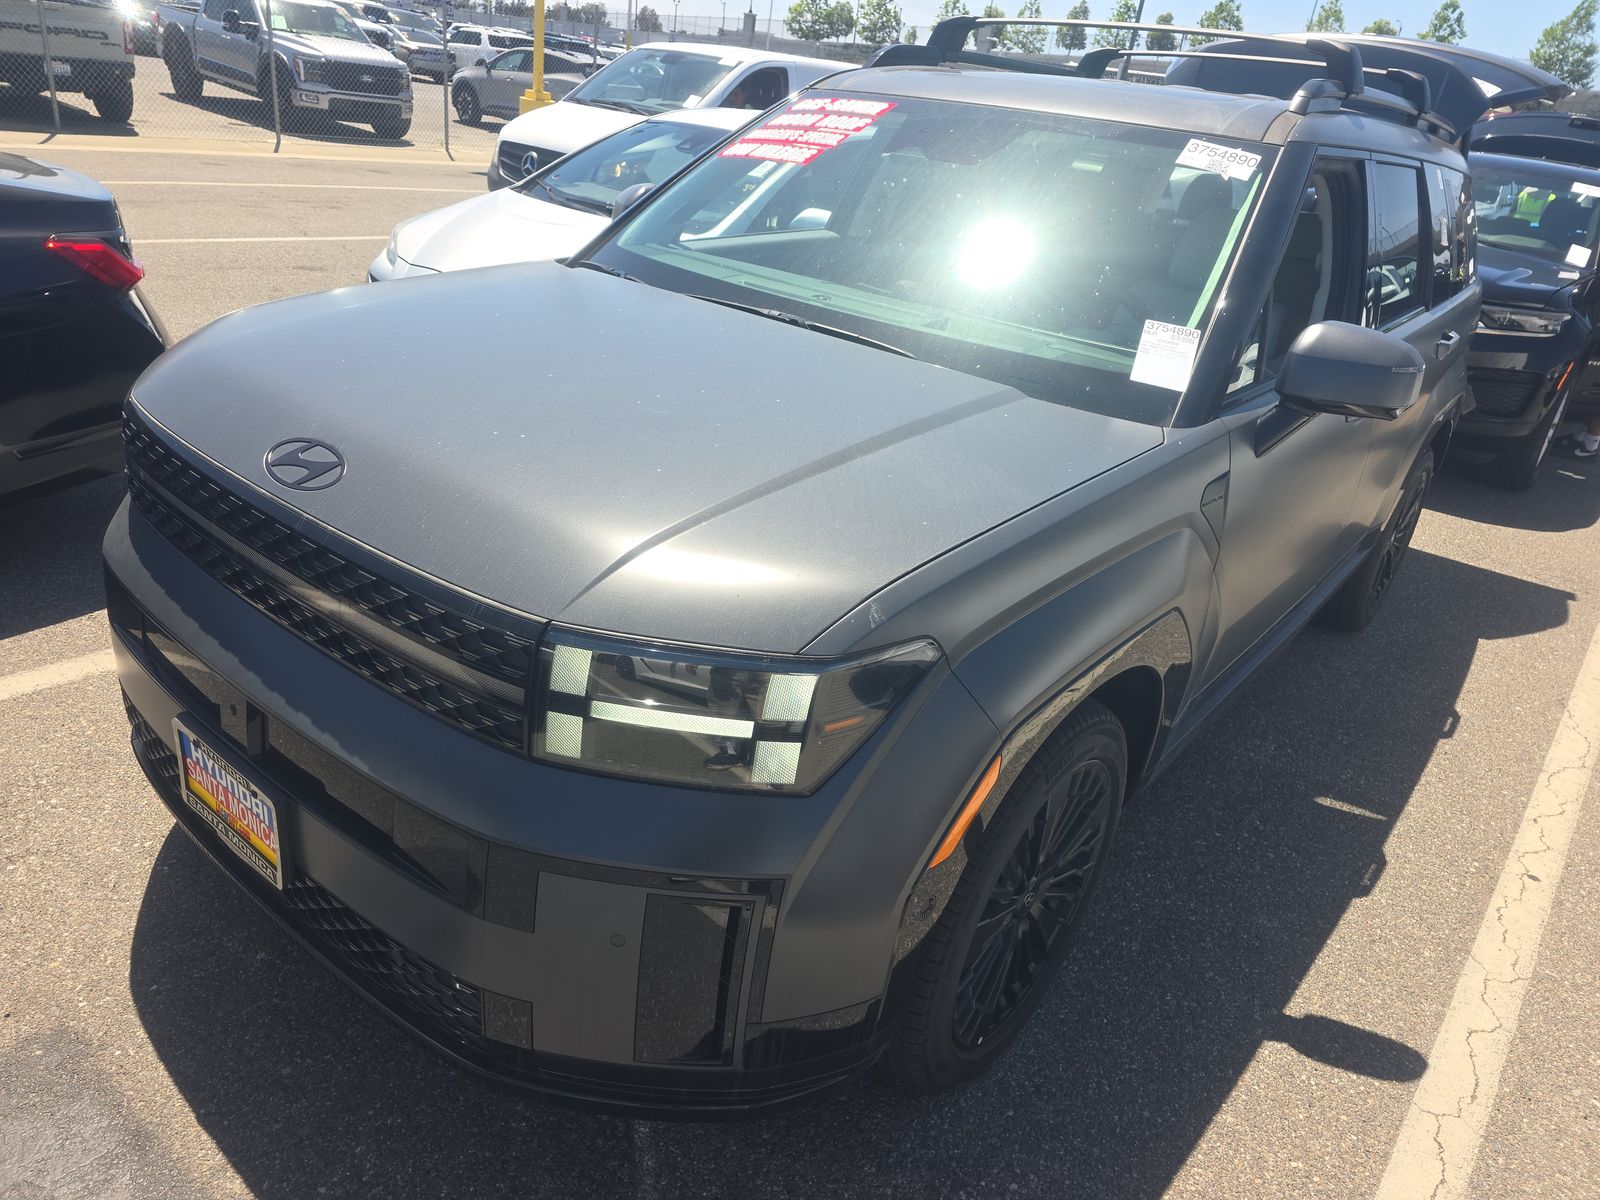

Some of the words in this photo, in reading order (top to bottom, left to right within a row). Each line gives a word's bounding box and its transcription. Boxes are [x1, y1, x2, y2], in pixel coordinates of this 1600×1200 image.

[1187, 142, 1259, 168] 3754890
[1147, 321, 1200, 339] 3754890
[185, 757, 227, 806] SANTA
[229, 796, 277, 850] MONICA
[189, 741, 270, 826] HYUNDAI
[189, 800, 226, 834] SANTA
[228, 832, 274, 880] MONICA
